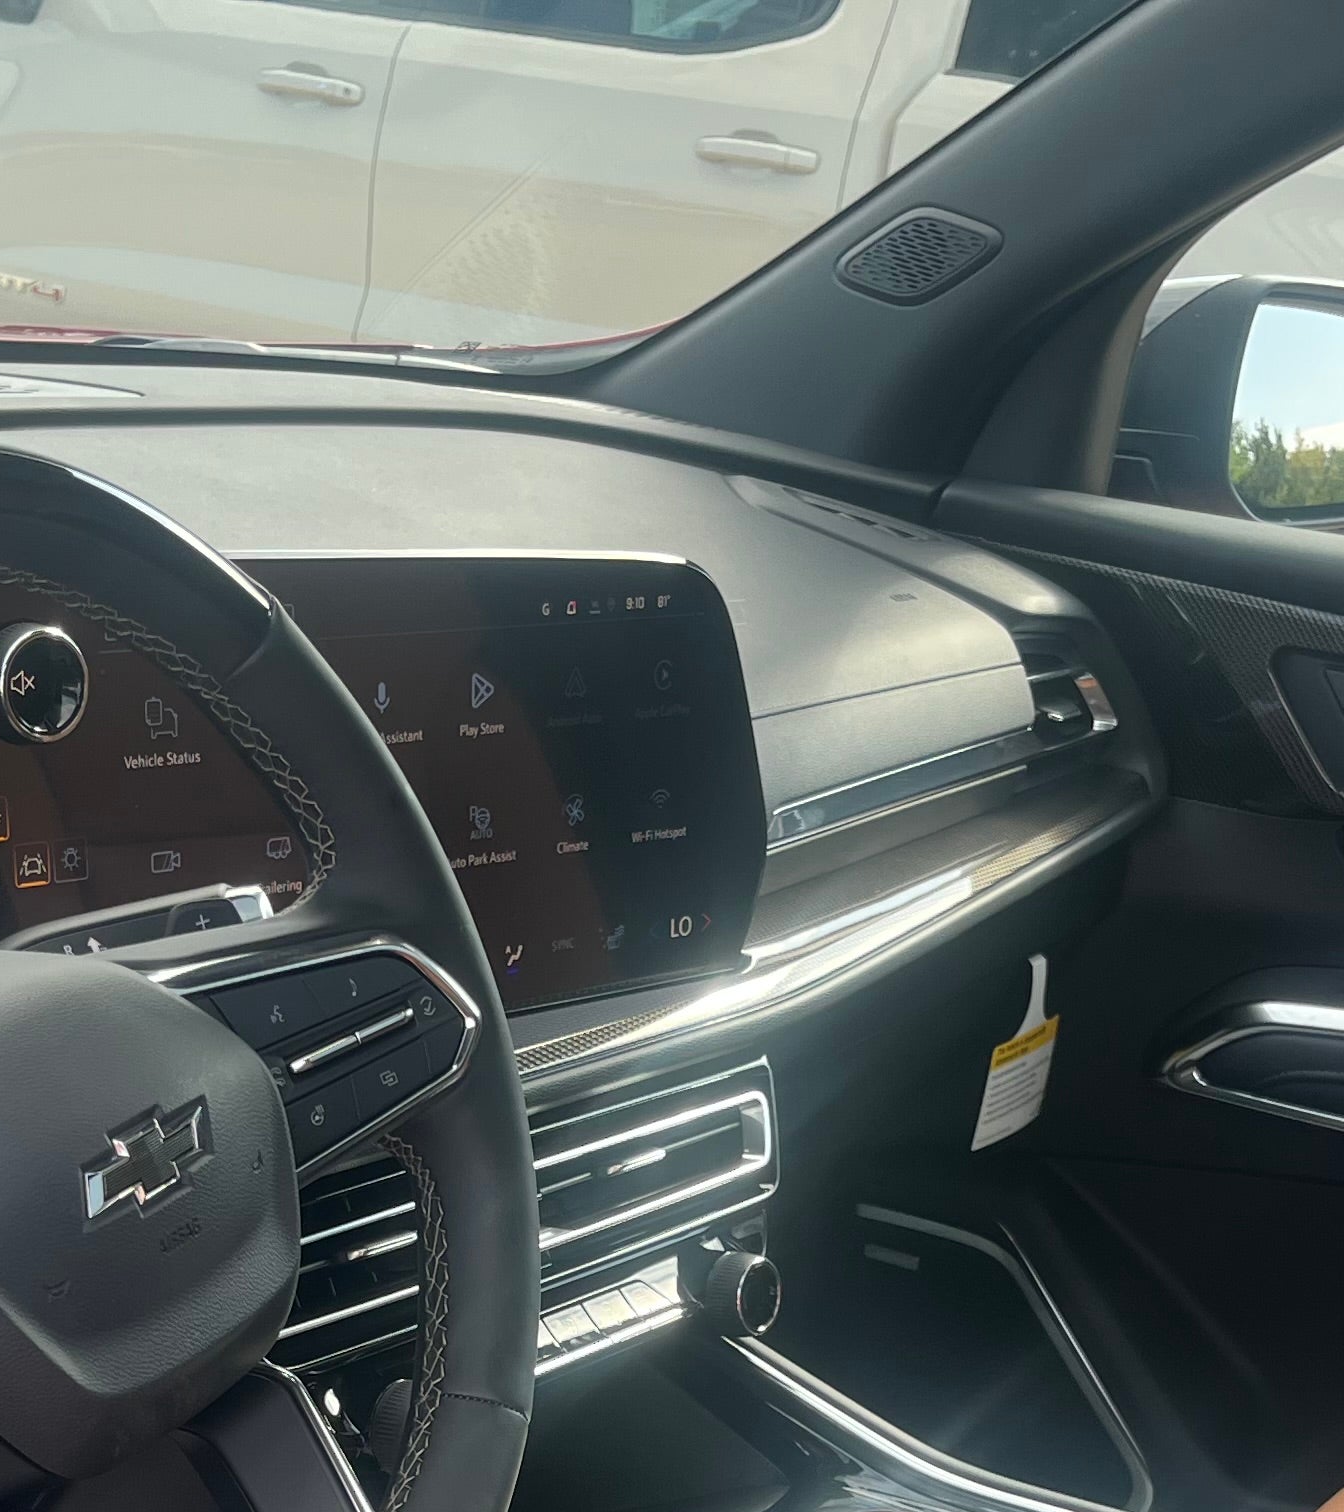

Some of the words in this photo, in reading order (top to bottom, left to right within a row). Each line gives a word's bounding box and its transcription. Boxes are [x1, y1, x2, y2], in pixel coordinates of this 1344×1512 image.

[459, 723, 478, 740] Play
[480, 721, 505, 736] Store
[124, 753, 164, 770] Vehicle
[166, 751, 201, 766] Status
[631, 831, 654, 844] Wi-Fi
[654, 826, 687, 841] Hotspot
[556, 841, 589, 855] Climate
[468, 854, 489, 867] Park
[489, 850, 516, 864] Assist
[669, 915, 693, 939] LO
